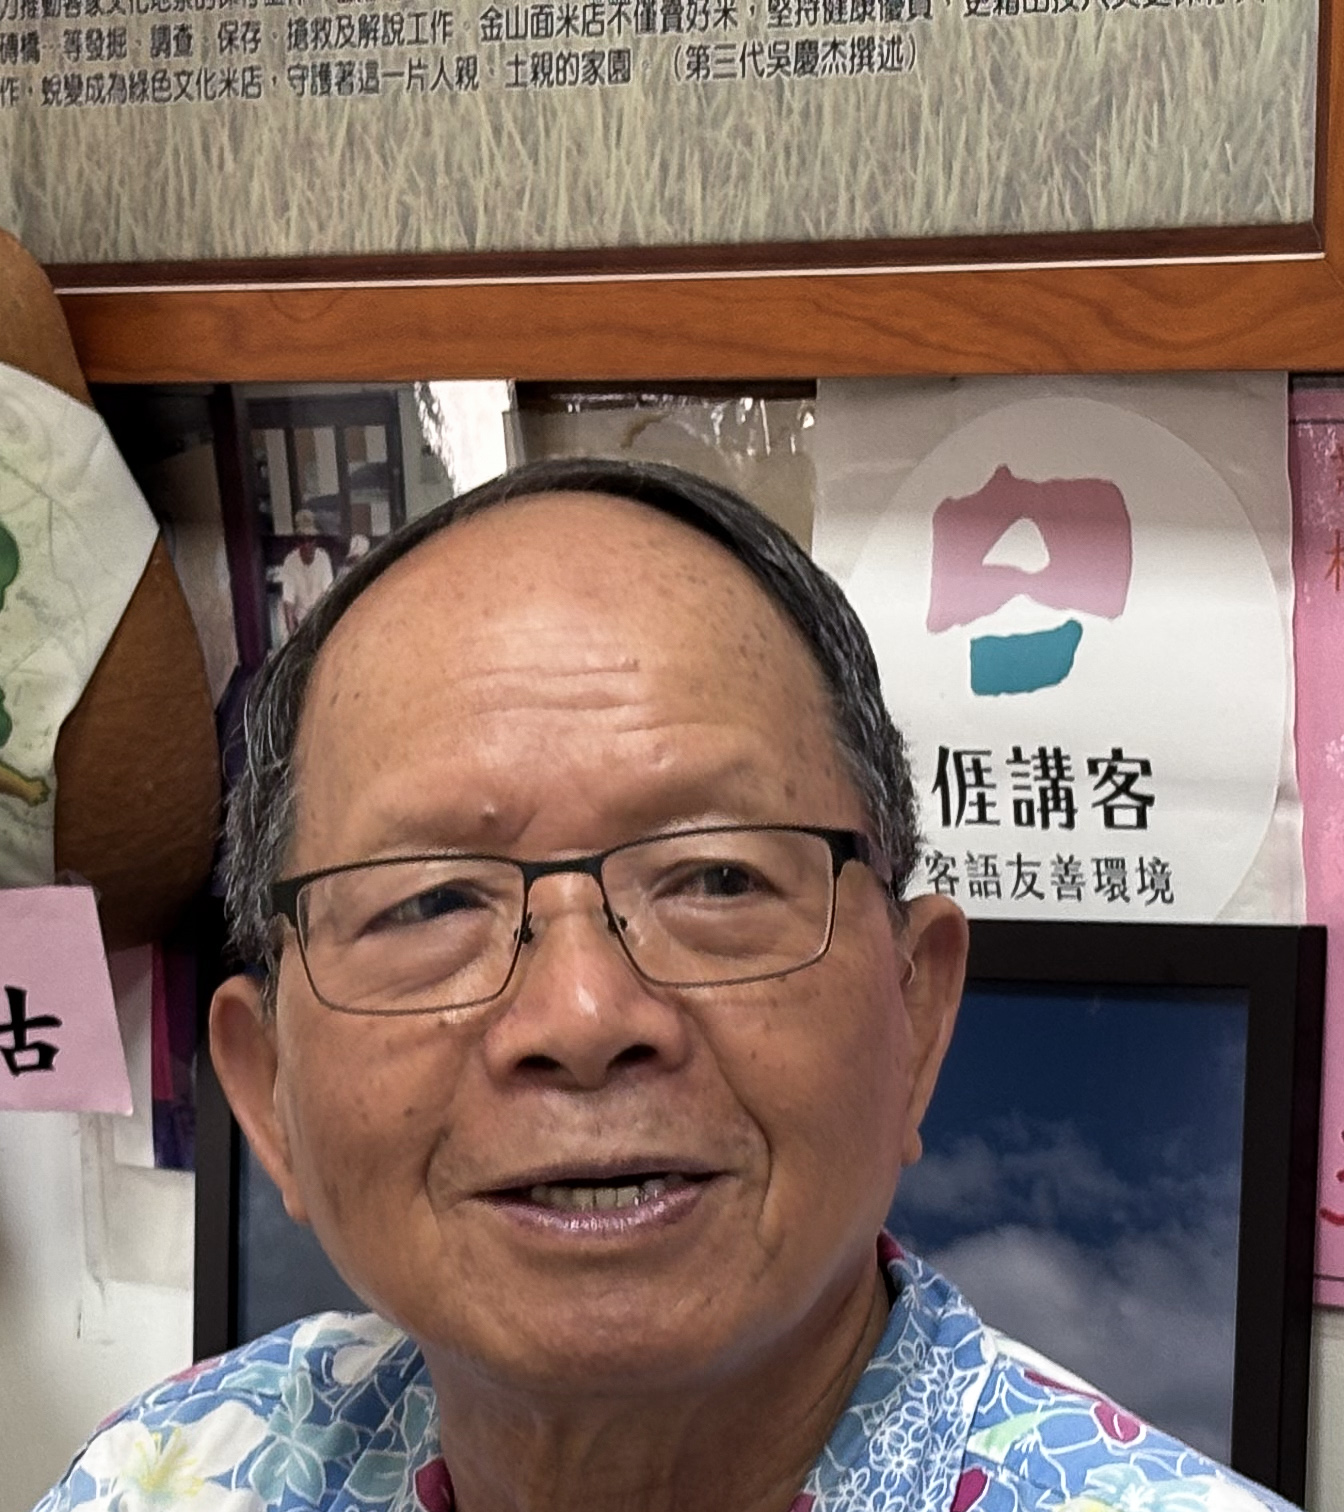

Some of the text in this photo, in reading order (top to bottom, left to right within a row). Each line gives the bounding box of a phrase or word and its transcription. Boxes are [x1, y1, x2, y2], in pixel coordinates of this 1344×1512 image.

[923, 849, 1176, 907] 客語友善環境
